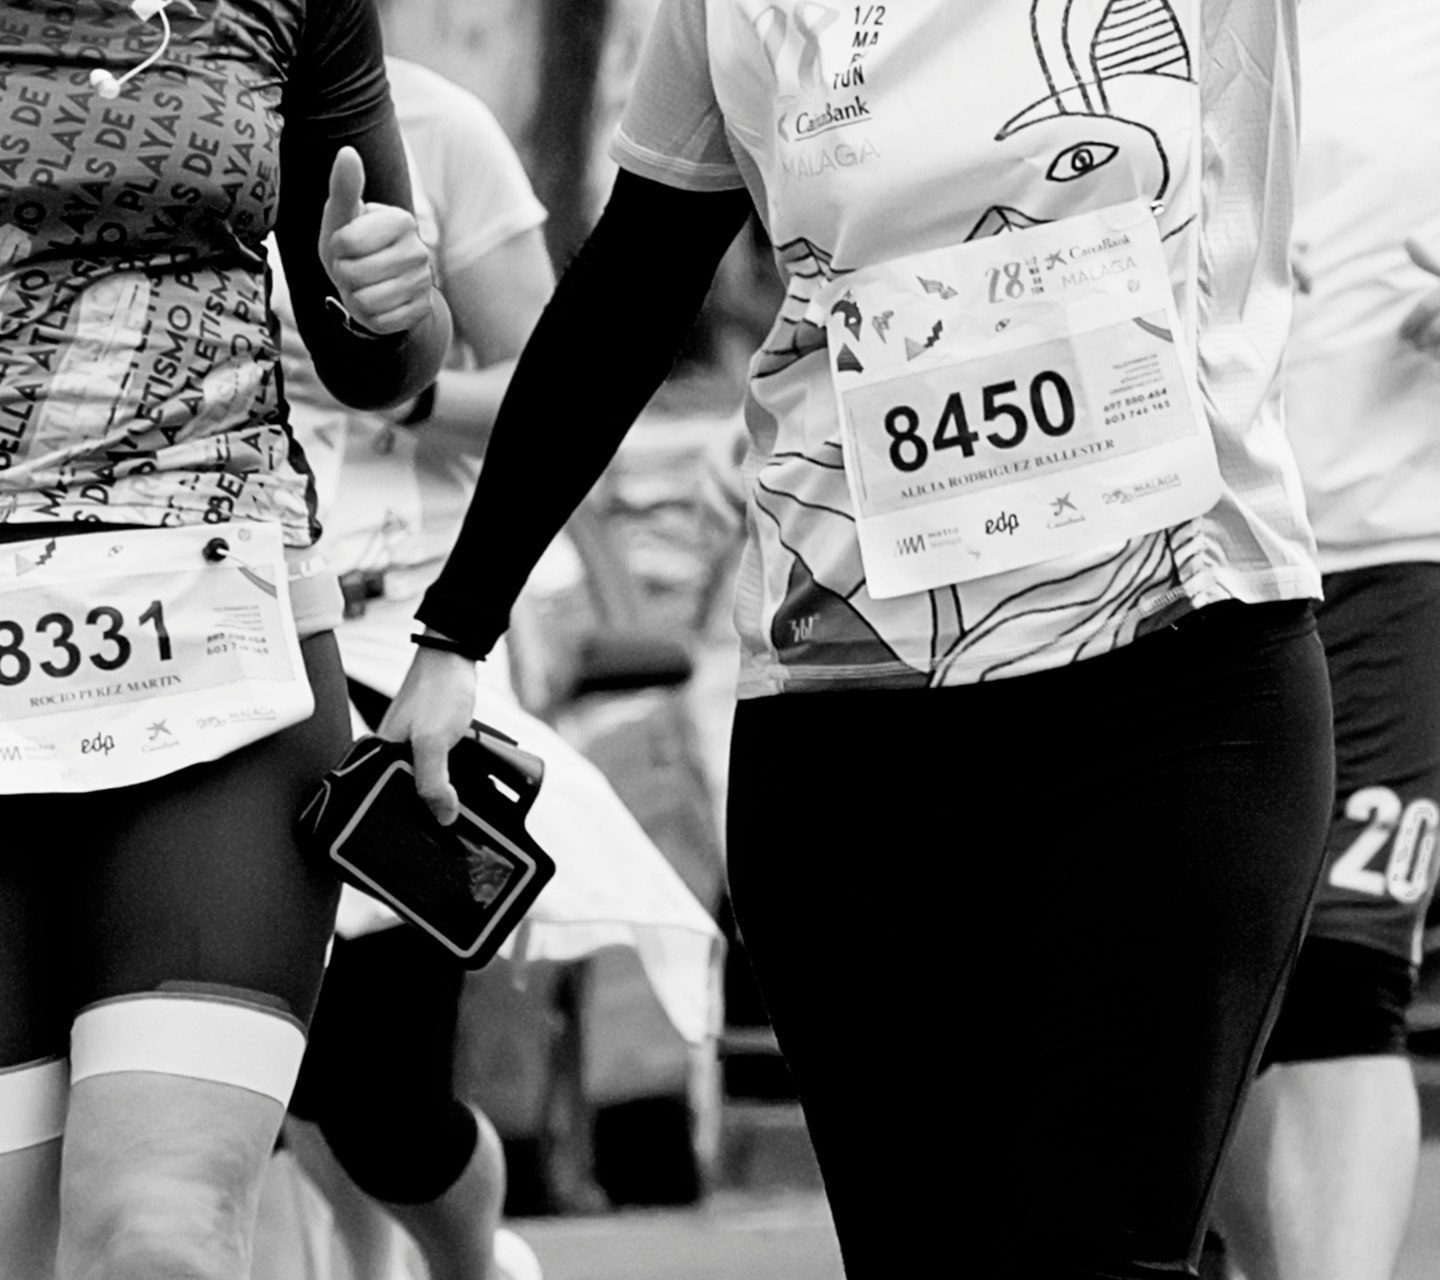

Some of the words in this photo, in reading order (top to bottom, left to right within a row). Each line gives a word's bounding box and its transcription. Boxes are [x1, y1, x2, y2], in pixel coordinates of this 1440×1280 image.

[853, 5, 887, 27] 1/2
[10, 85, 51, 128] DE
[95, 107, 135, 151] DE
[115, 91, 186, 213] PLAYAS
[183, 132, 220, 177] DE
[177, 273, 232, 412] ATLETISM
[883, 369, 1076, 473] 8450
[900, 481, 946, 500] ALICIA
[948, 457, 1033, 488] RODRIGUEZ
[1035, 438, 1116, 469] BALLESTER
[984, 510, 1021, 537] edp
[127, 674, 183, 693] MARTIN
[80, 731, 116, 756] edp
